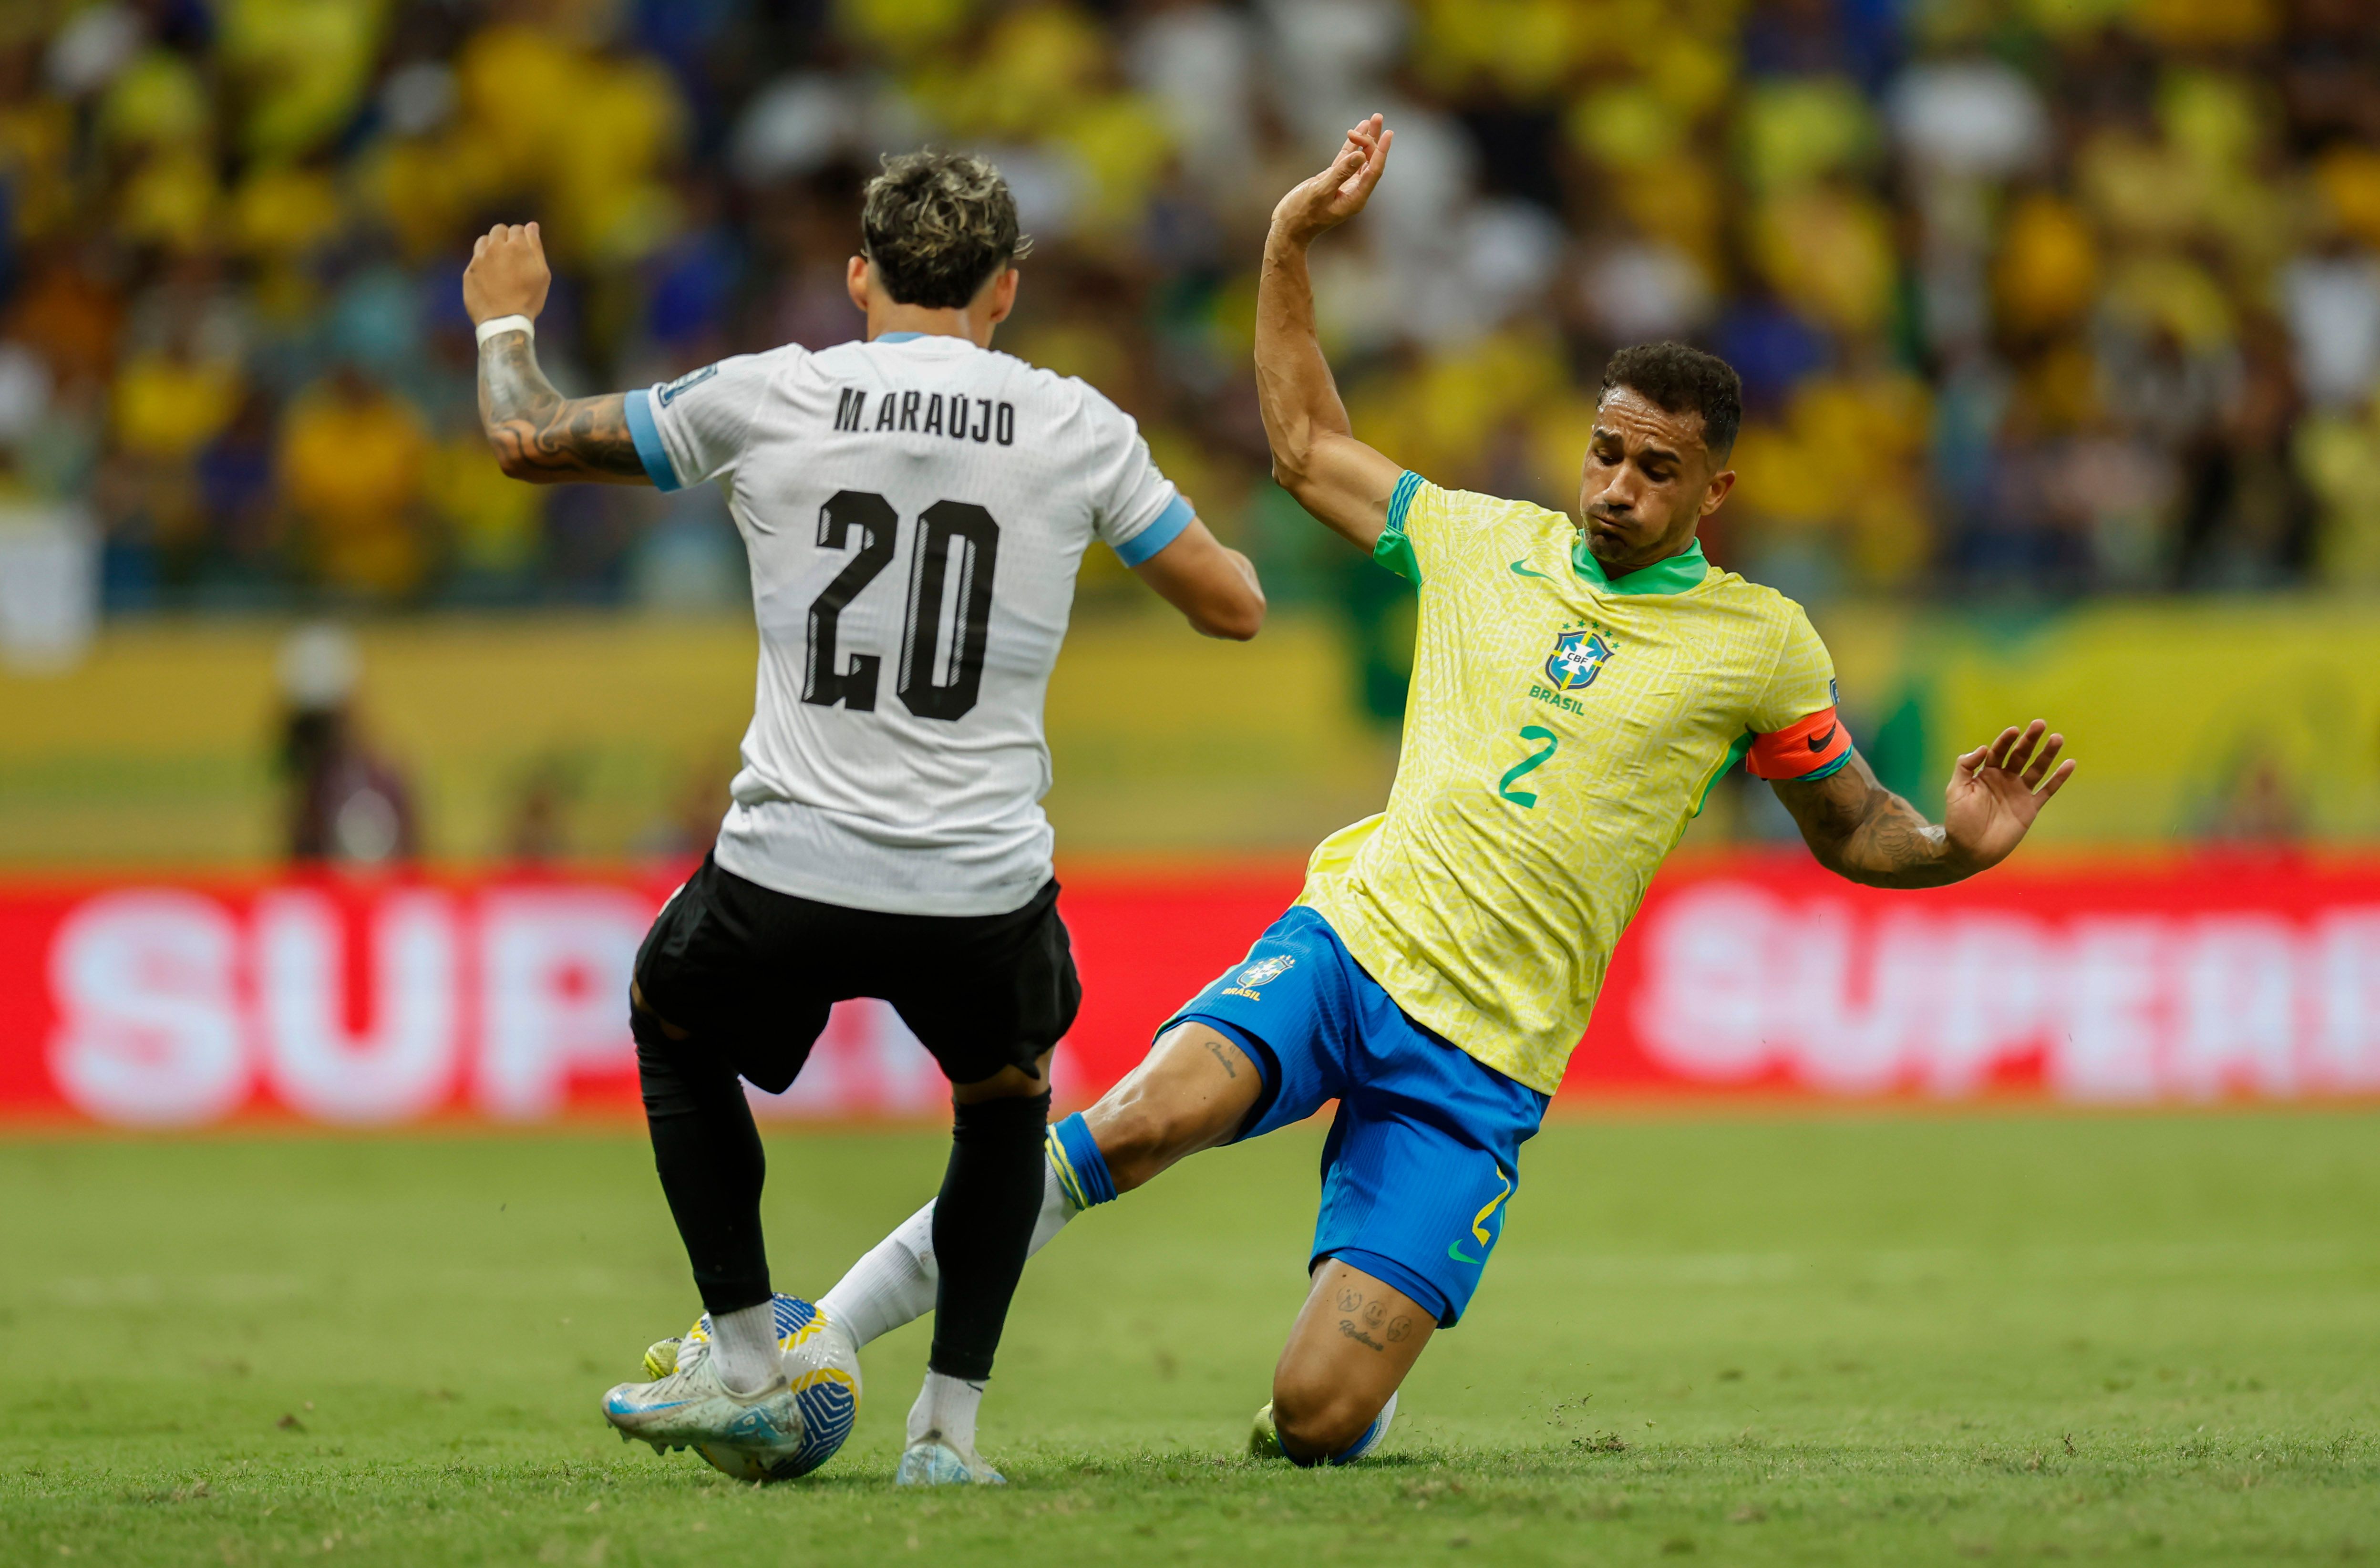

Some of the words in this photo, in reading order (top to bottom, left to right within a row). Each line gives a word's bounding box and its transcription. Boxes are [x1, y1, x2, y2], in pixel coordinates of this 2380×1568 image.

[801, 489, 1000, 722] 20
[1567, 652, 1589, 664] CBF
[1529, 684, 1585, 716] BRASIL
[1498, 725, 1558, 809] 2
[1221, 988, 1260, 1001] BRASIL
